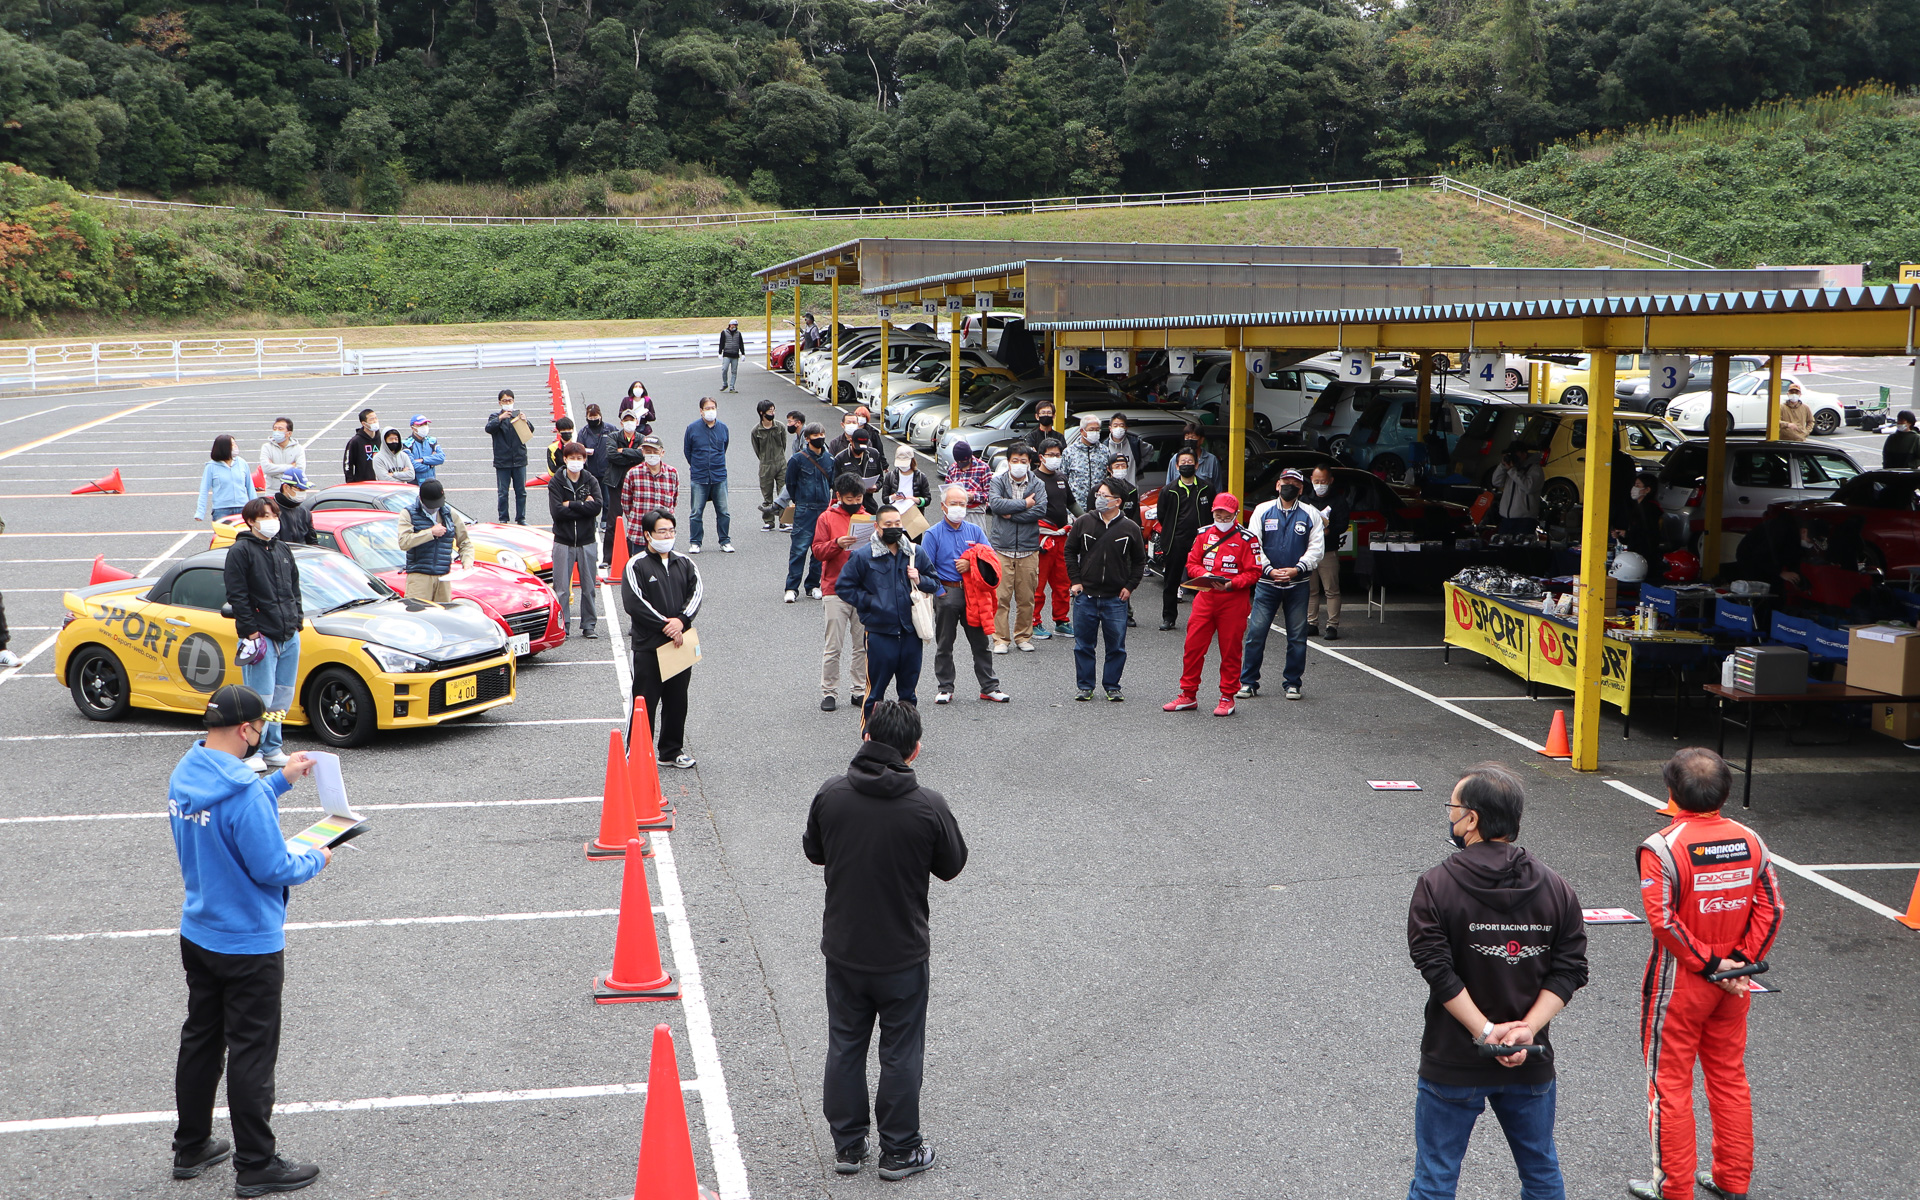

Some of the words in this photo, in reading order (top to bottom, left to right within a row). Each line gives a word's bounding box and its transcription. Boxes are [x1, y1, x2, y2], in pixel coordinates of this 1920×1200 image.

[924, 304, 936, 312] 13
[949, 300, 960, 309] 12
[978, 298, 990, 307] 11
[1065, 355, 1073, 366] 9
[1113, 356, 1122, 368] 8
[1176, 356, 1186, 368] 7
[1253, 358, 1263, 373] 6
[1350, 360, 1362, 375] 5
[1480, 364, 1494, 381] 4
[1662, 366, 1676, 388] 3
[93, 600, 178, 658] SPORT
[1471, 598, 1524, 652] SPORT
[1697, 870, 1750, 882] DIXCEL
